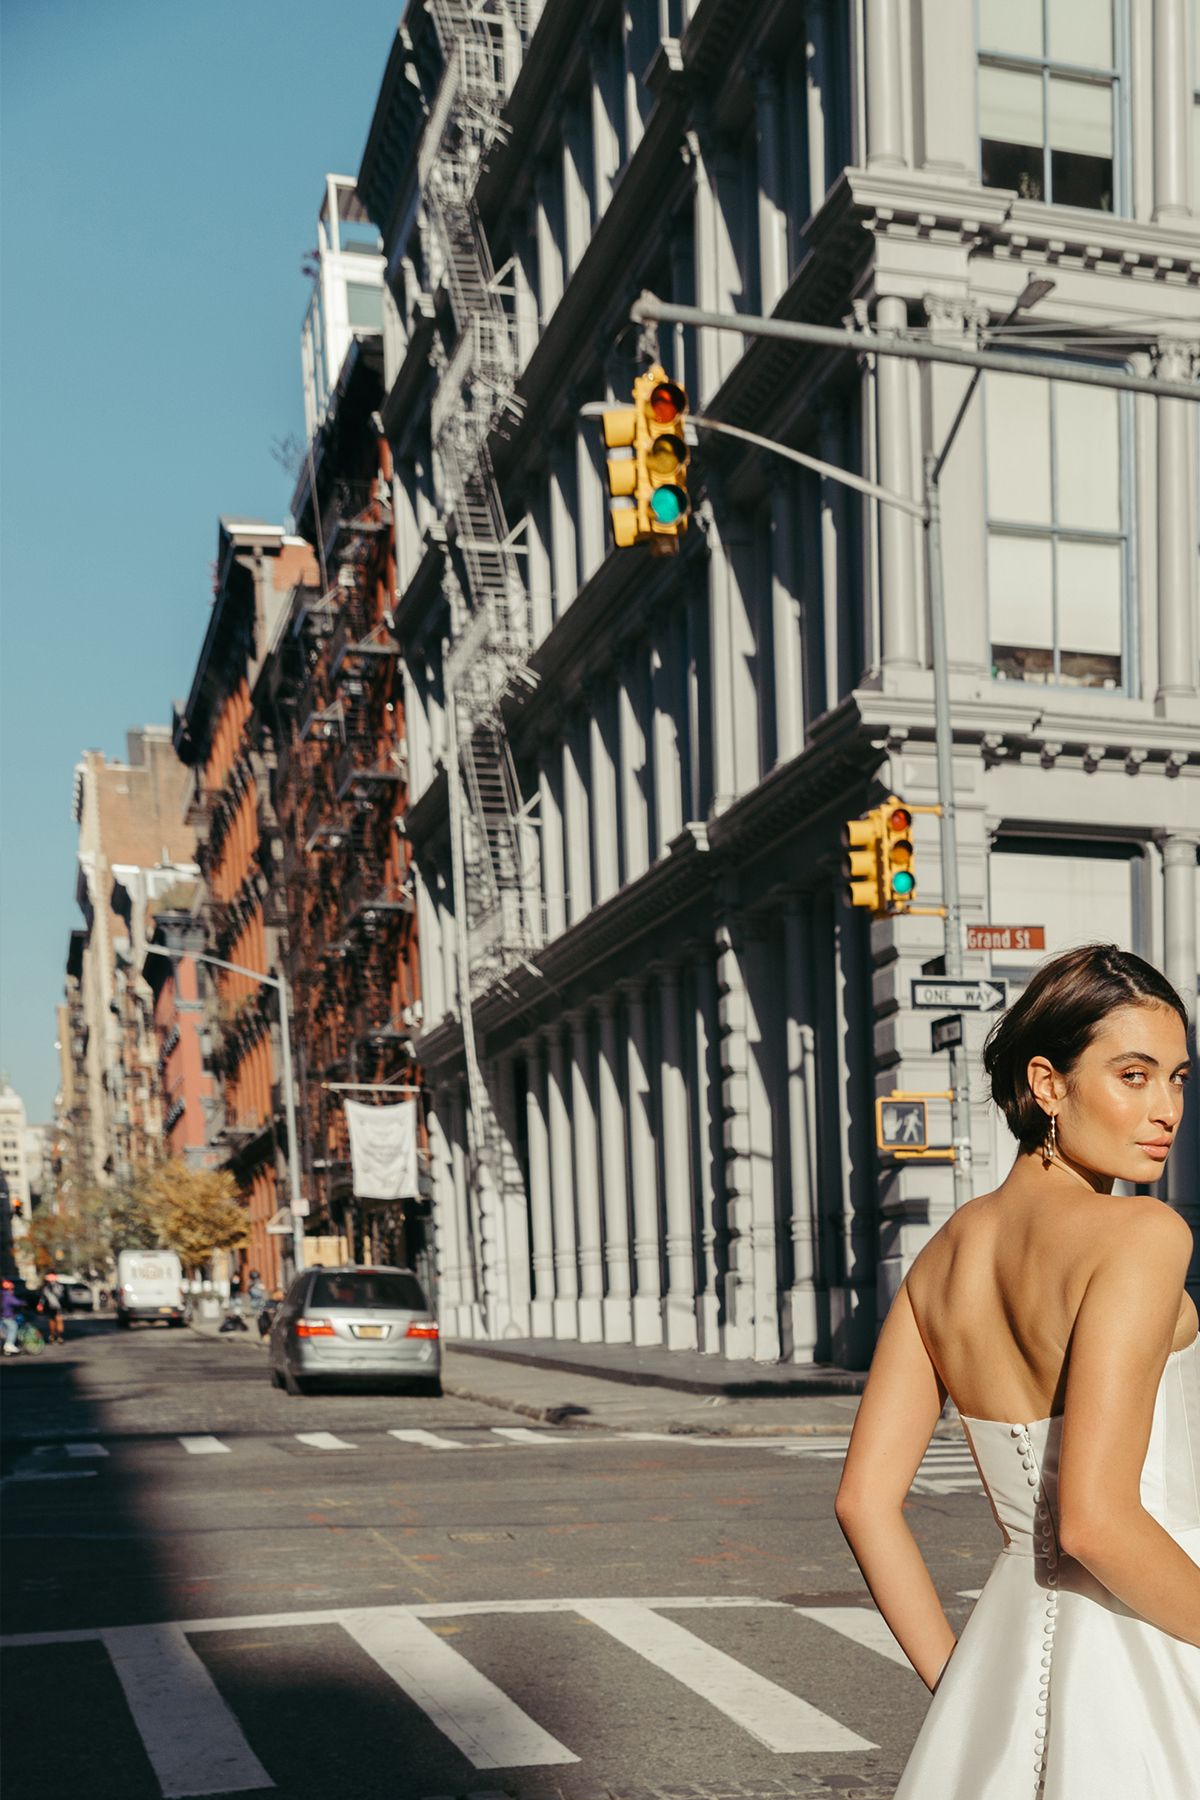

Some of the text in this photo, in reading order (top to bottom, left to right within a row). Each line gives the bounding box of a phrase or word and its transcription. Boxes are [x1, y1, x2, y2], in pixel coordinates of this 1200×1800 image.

[967, 928, 1031, 949] Grand St
[924, 988, 993, 1002] ONE WAY
